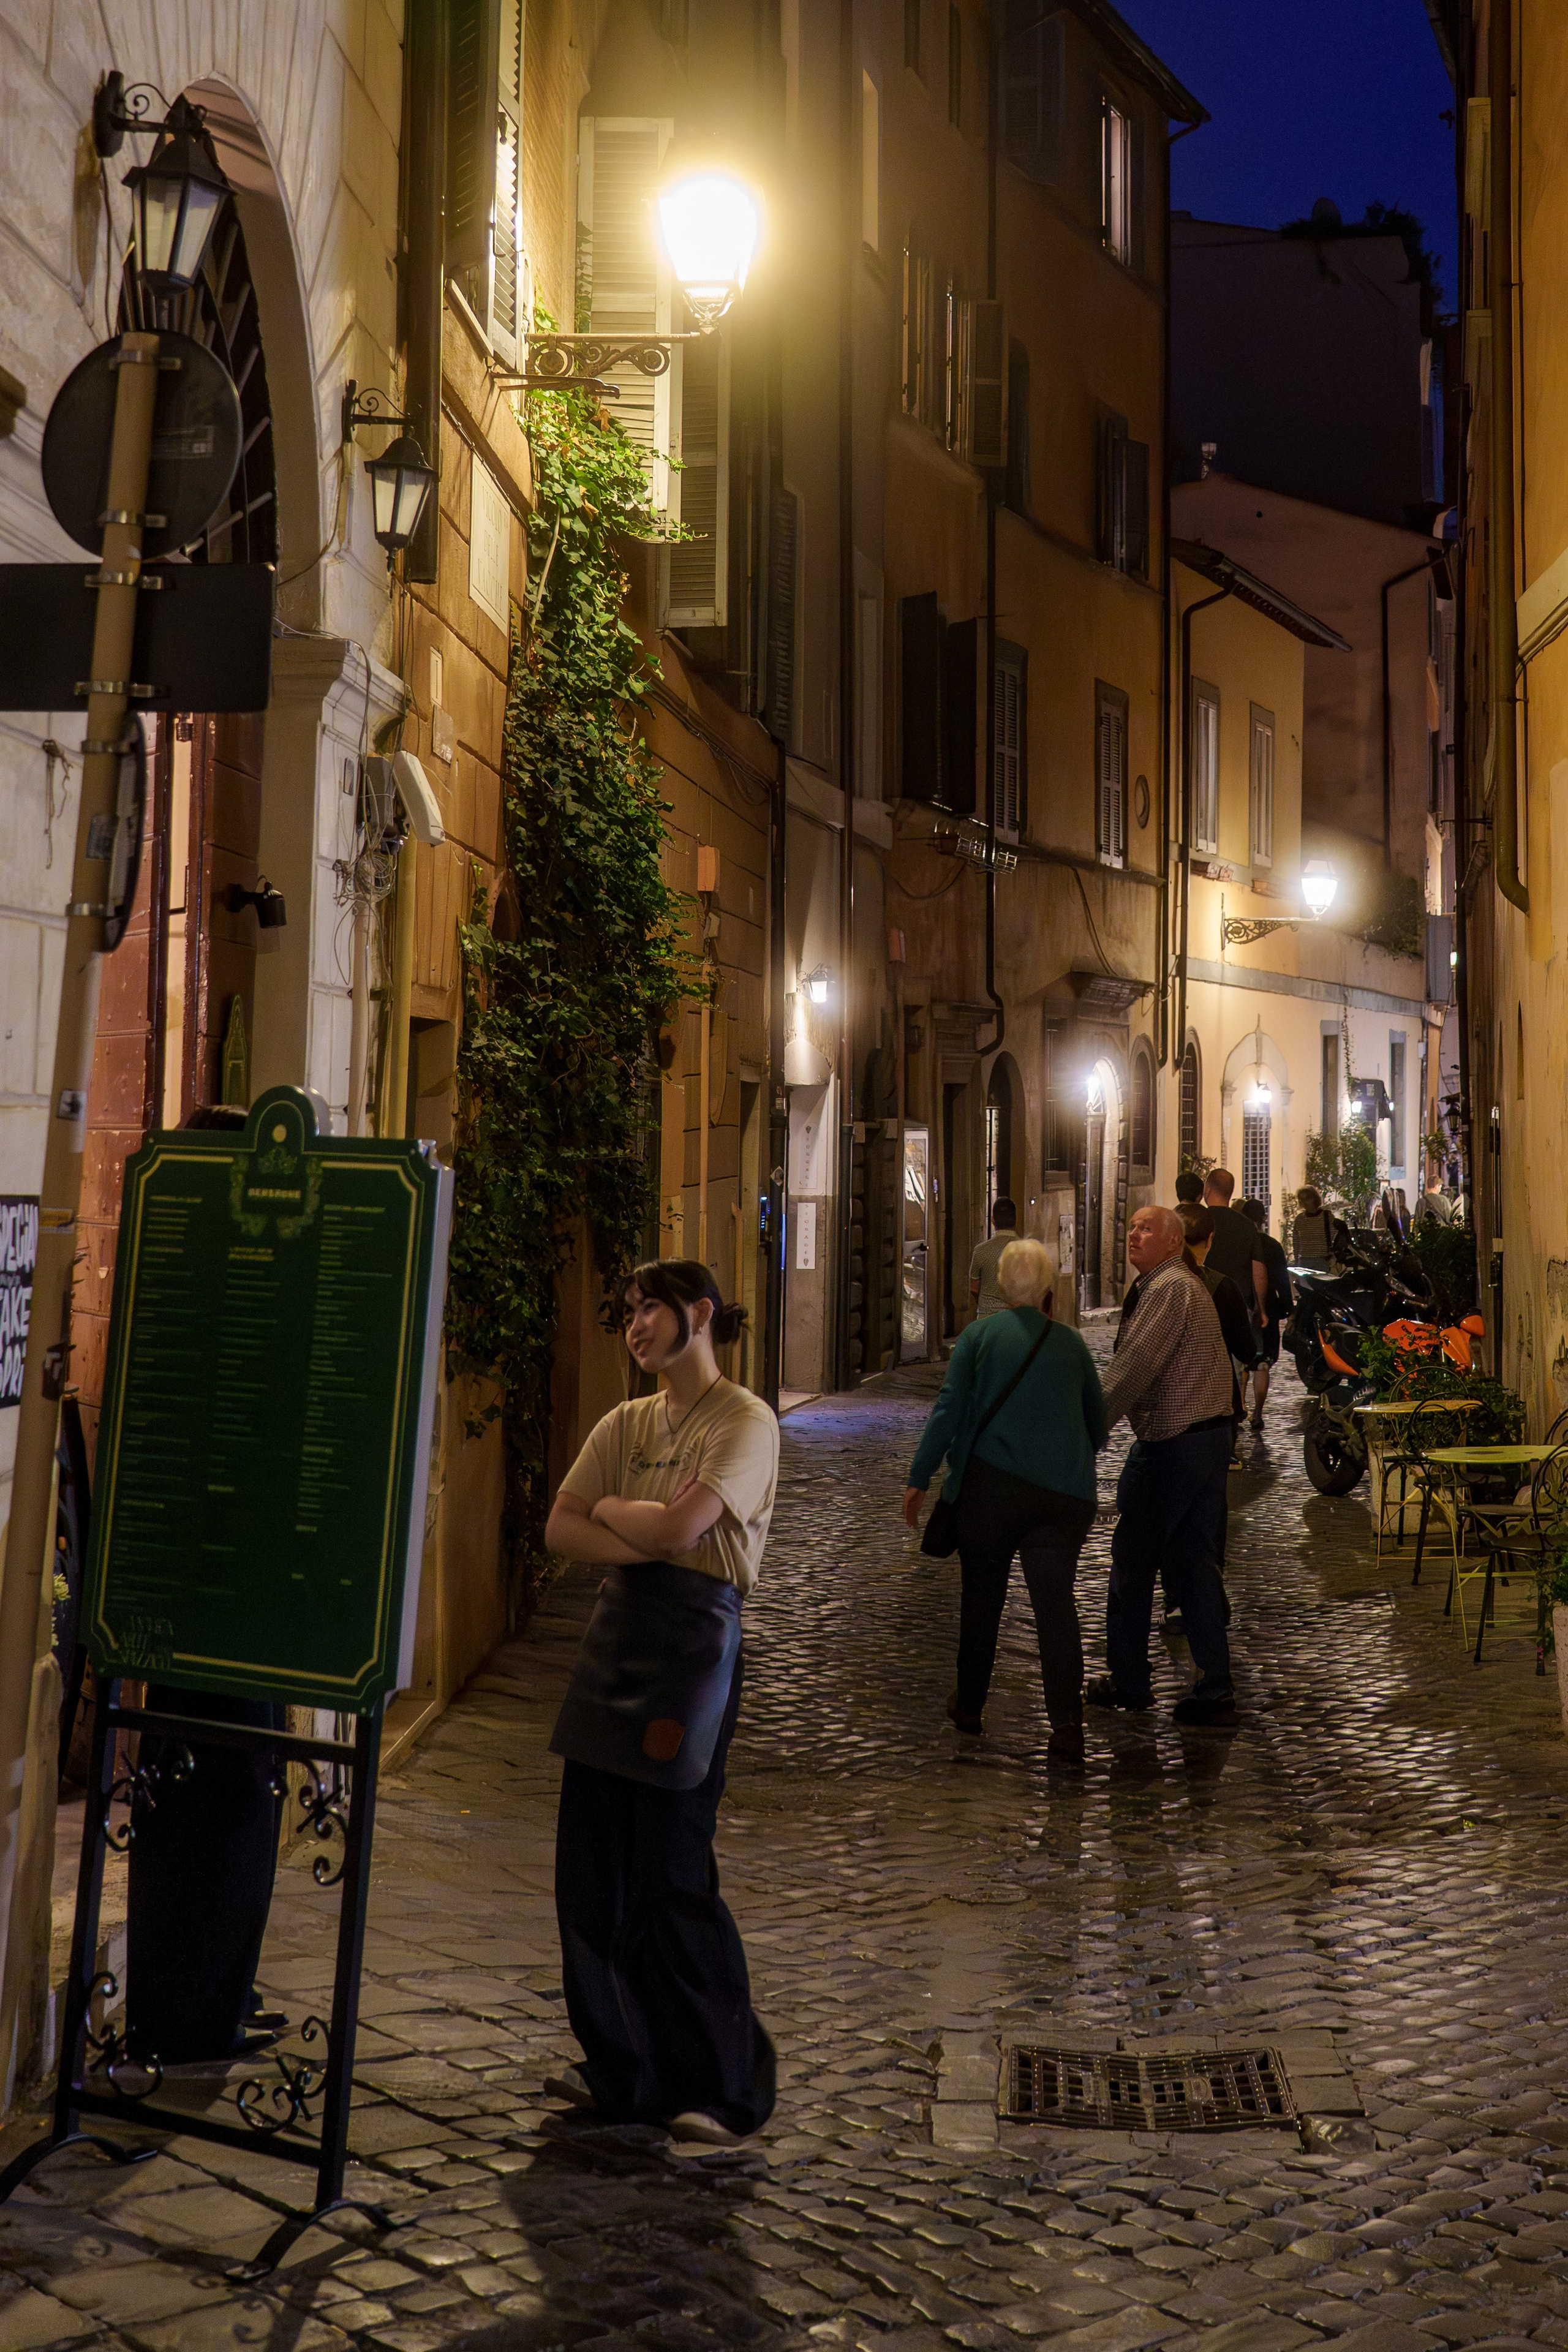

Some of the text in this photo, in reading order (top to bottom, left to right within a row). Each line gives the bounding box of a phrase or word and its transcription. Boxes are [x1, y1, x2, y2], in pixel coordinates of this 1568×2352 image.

[482, 486, 502, 534] VICOLO
[484, 529, 499, 567] DELLE
[478, 558, 502, 611] VACCHE
